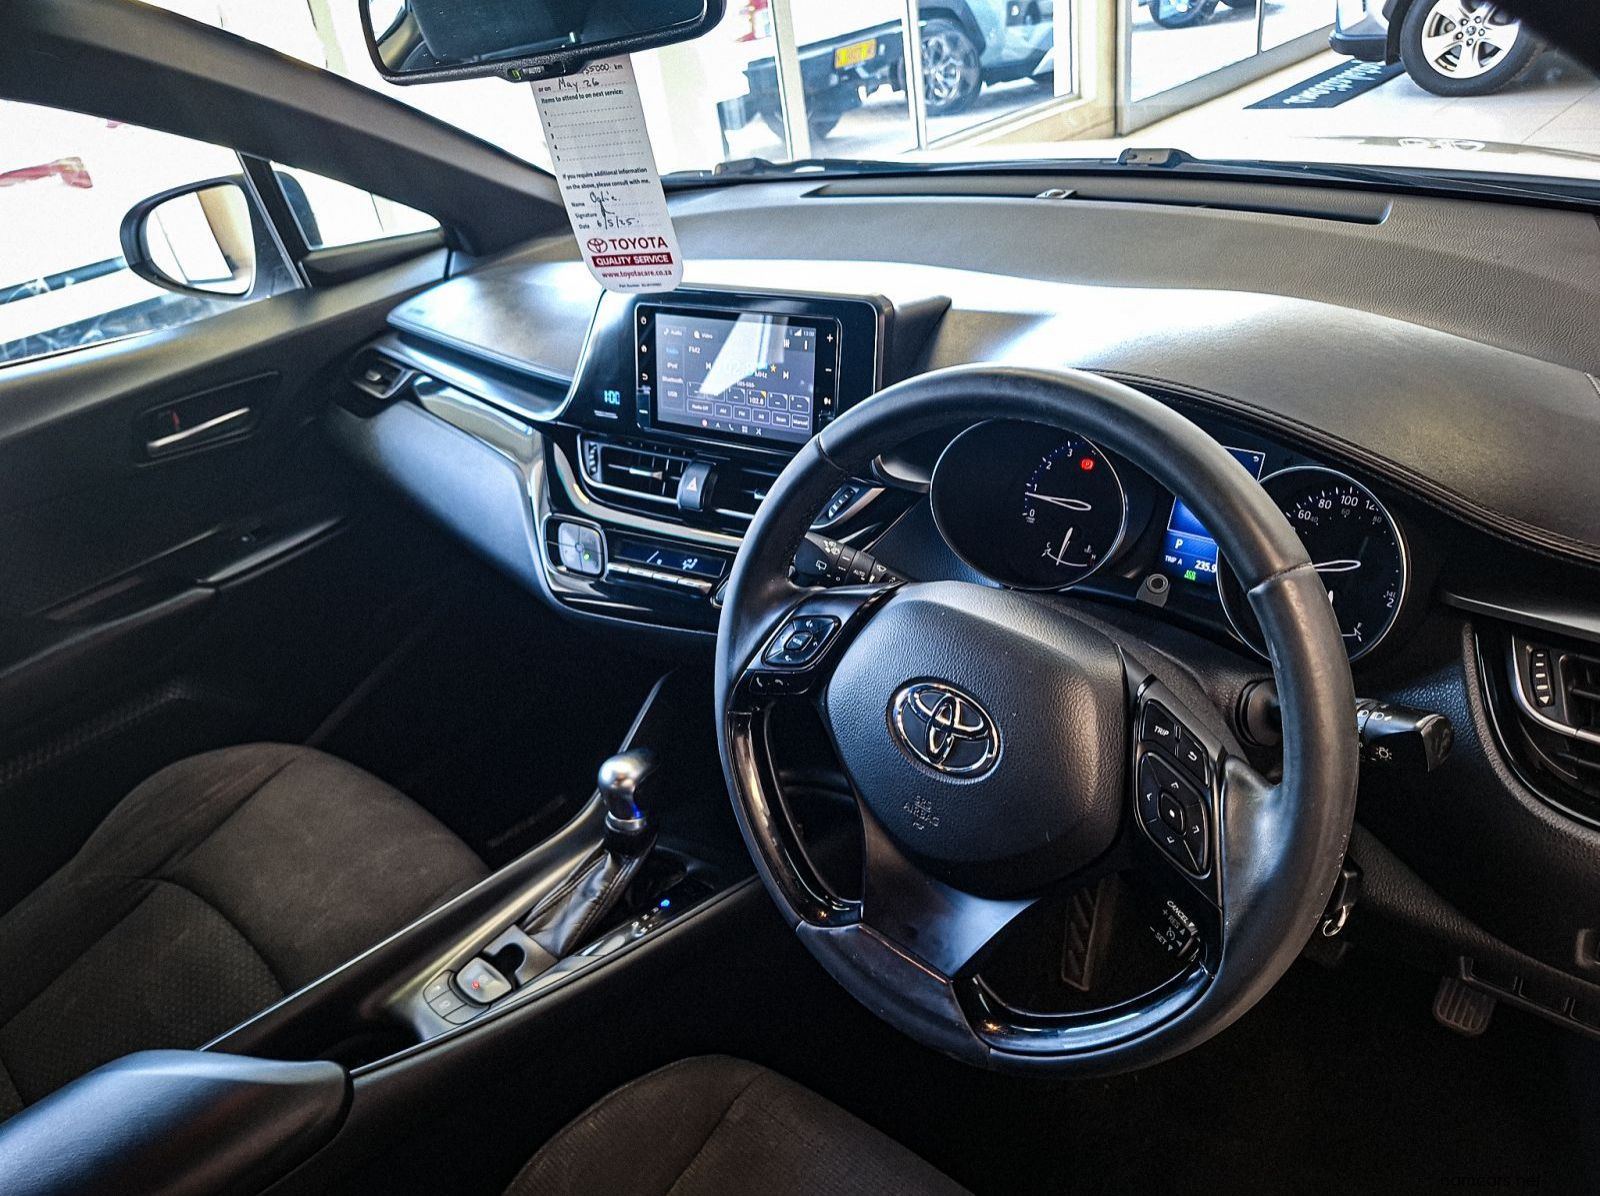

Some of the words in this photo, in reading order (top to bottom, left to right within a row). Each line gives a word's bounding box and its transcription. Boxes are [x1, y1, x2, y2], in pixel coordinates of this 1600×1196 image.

[558, 77, 579, 93] May
[562, 94, 579, 102] attend
[576, 172, 593, 180] require
[594, 169, 618, 177] additional
[618, 167, 648, 175] information
[596, 181, 611, 190] please
[611, 179, 629, 187] consult
[575, 212, 598, 220] Signature
[608, 236, 669, 251] TOYOTA
[596, 256, 632, 266] QUALITY
[633, 254, 670, 264] SERVICE
[602, 269, 673, 280] www.toyotacare.co.za
[1066, 448, 1073, 458] 3
[1045, 460, 1052, 470] 2
[1034, 483, 1038, 492] 1
[1318, 498, 1332, 510] 80
[1340, 494, 1359, 507] 100
[1365, 500, 1378, 511] 12
[1029, 508, 1036, 517] 0
[1297, 509, 1312, 520] 60
[1341, 508, 1351, 516] 60
[1174, 538, 1184, 549] P
[1165, 555, 1177, 563] TRIP
[1177, 558, 1183, 566] A
[1154, 725, 1170, 736] TRIP
[1167, 900, 1189, 924] CANCEL
[1155, 932, 1168, 945] SET
